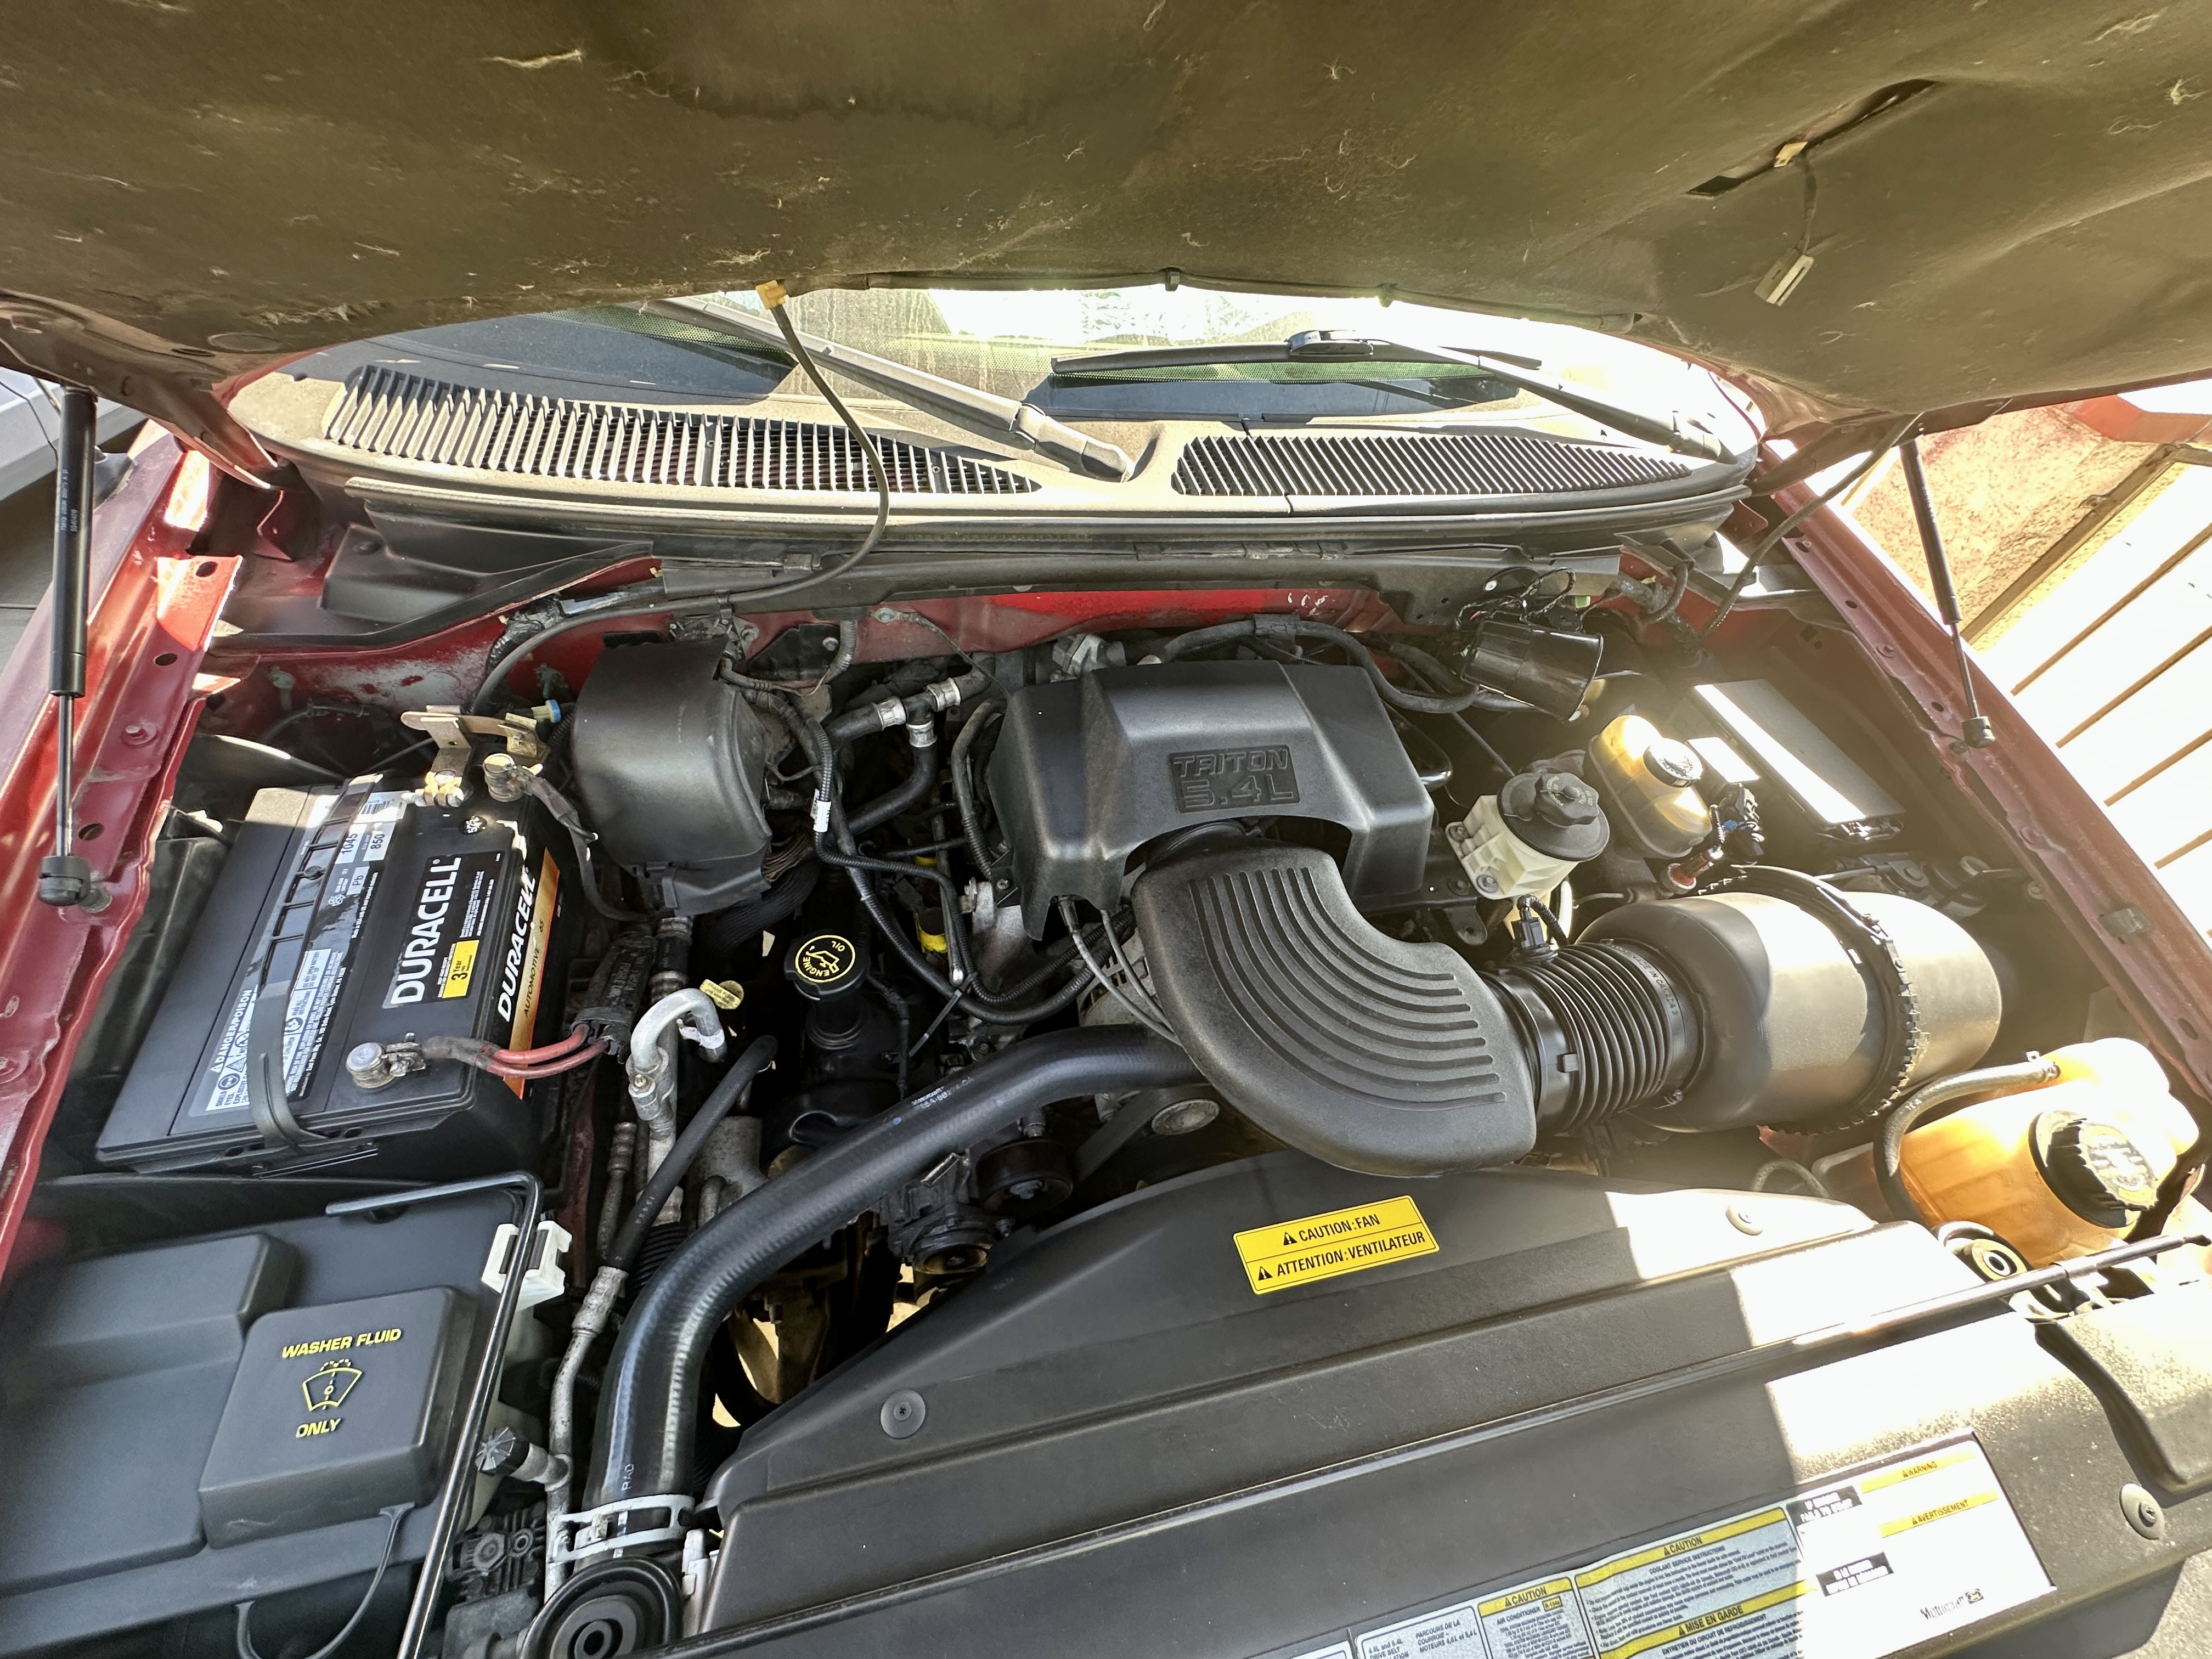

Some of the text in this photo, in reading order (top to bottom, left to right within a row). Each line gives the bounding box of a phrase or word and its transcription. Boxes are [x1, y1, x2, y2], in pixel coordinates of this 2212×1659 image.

[1173, 749, 1288, 777] TRITON
[1182, 774, 1294, 808] 5.4L
[370, 833, 385, 849] 850
[351, 874, 364, 885] Pb
[391, 856, 461, 1005] DURACELL
[498, 873, 535, 1022] DURACELL
[803, 940, 846, 977] ENGINE OIL
[450, 959, 469, 982] 3 Year
[523, 946, 541, 1015] AUTOMOTIVE
[218, 989, 252, 1064] DANGER/POISON
[282, 1328, 402, 1358] WASHER FLUID
[296, 1418, 341, 1438] ONLY
[1907, 1460, 1937, 1476] WARNING
[1917, 1499, 1969, 1523] AVERTISSEMENT
[1669, 1536, 1703, 1554] CAUTION
[1512, 1586, 1547, 1605] CAUTION
[1505, 1606, 1541, 1622] CONDITIONER
[1685, 1605, 1743, 1632] MISE EN GARDE
[1415, 1624, 1443, 1639] PARCOURS
[1417, 1632, 1445, 1646] COURROIE
[1380, 1641, 1391, 1650] and
[1387, 1646, 1400, 1656] BELT
[1419, 1639, 1446, 1652] MOTEURS
